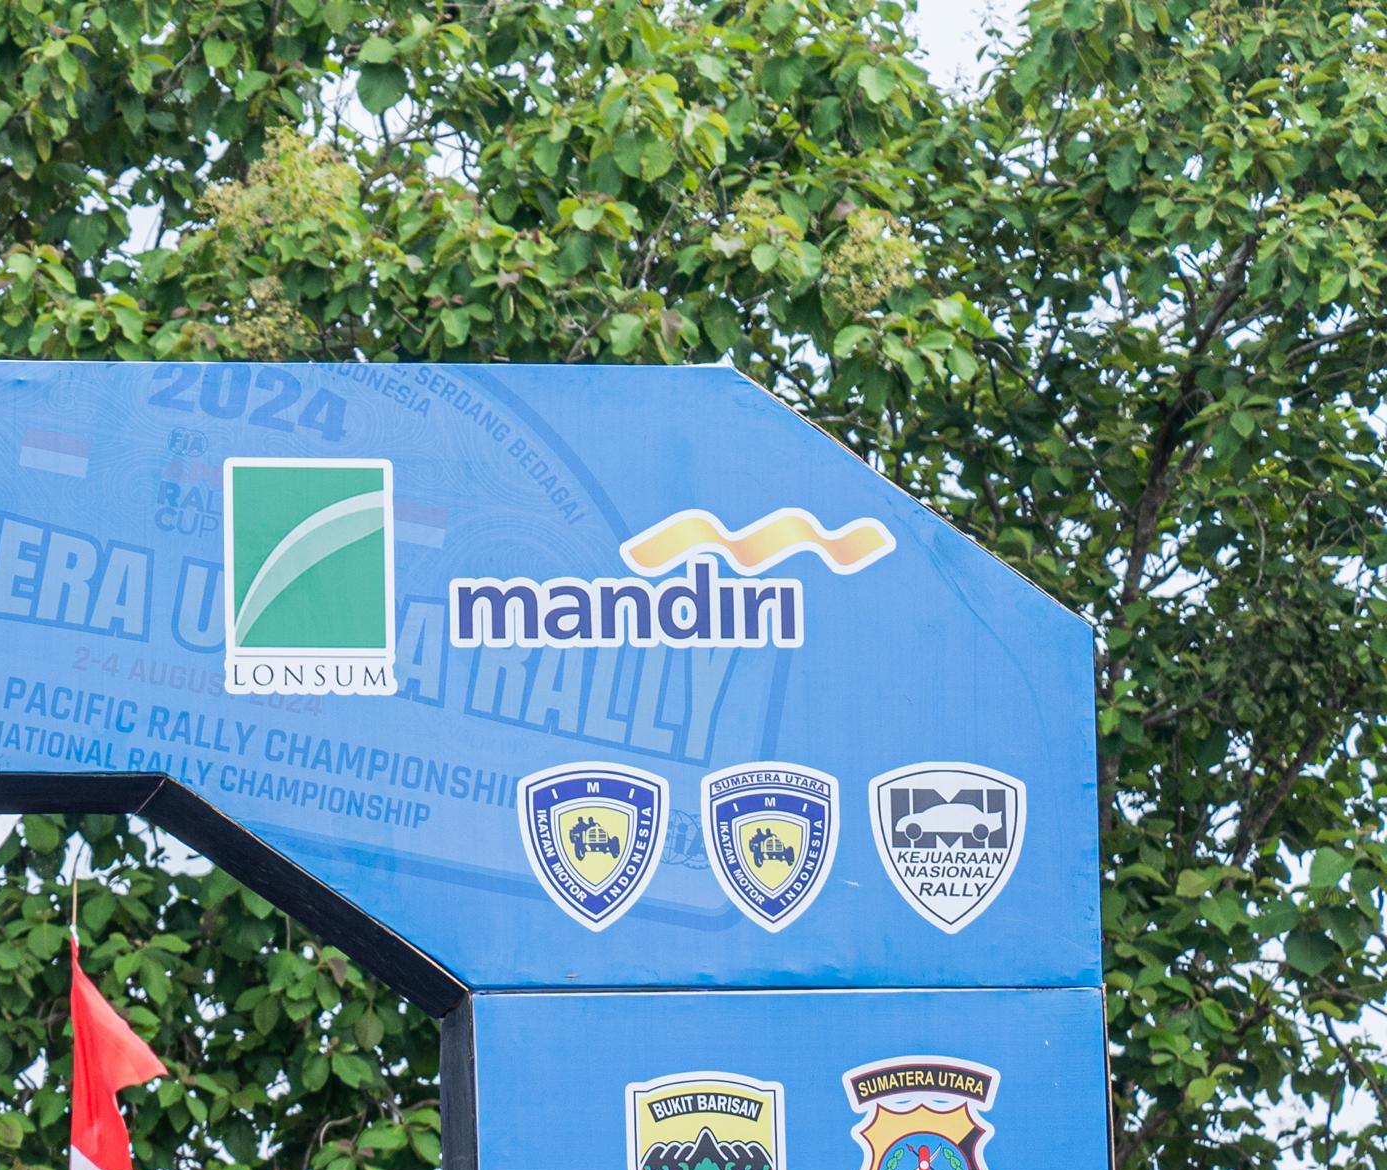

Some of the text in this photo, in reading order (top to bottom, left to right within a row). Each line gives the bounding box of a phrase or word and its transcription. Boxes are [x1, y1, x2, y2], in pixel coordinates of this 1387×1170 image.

[148, 363, 348, 443] 2024
[413, 364, 587, 526] SERDANG BEDAGAI
[156, 481, 223, 516] RAL
[457, 561, 798, 641] mandiri
[127, 657, 226, 697] AUGUS
[233, 663, 389, 688] LONSUM
[2, 675, 139, 734] PACIFIC
[146, 705, 258, 757] RALLY
[263, 727, 520, 812] CHAMPIONSHI
[219, 765, 432, 829] CHAMPIONSHIP
[713, 773, 827, 794] SUMATERA UTARA
[536, 807, 557, 859] IKATAN
[551, 862, 589, 904] MOTOR
[601, 805, 653, 905] INDONESIA
[719, 820, 738, 867] IKATAN
[732, 868, 766, 907] MOTOR
[778, 818, 824, 908] INDONESIA
[896, 850, 1004, 865] KEJUARAAN
[903, 865, 996, 879] NASIONAL
[918, 882, 988, 898] RALLY
[857, 1070, 985, 1098] SUMATERA UTARA
[651, 1094, 760, 1119] BUKIT BARISAN
